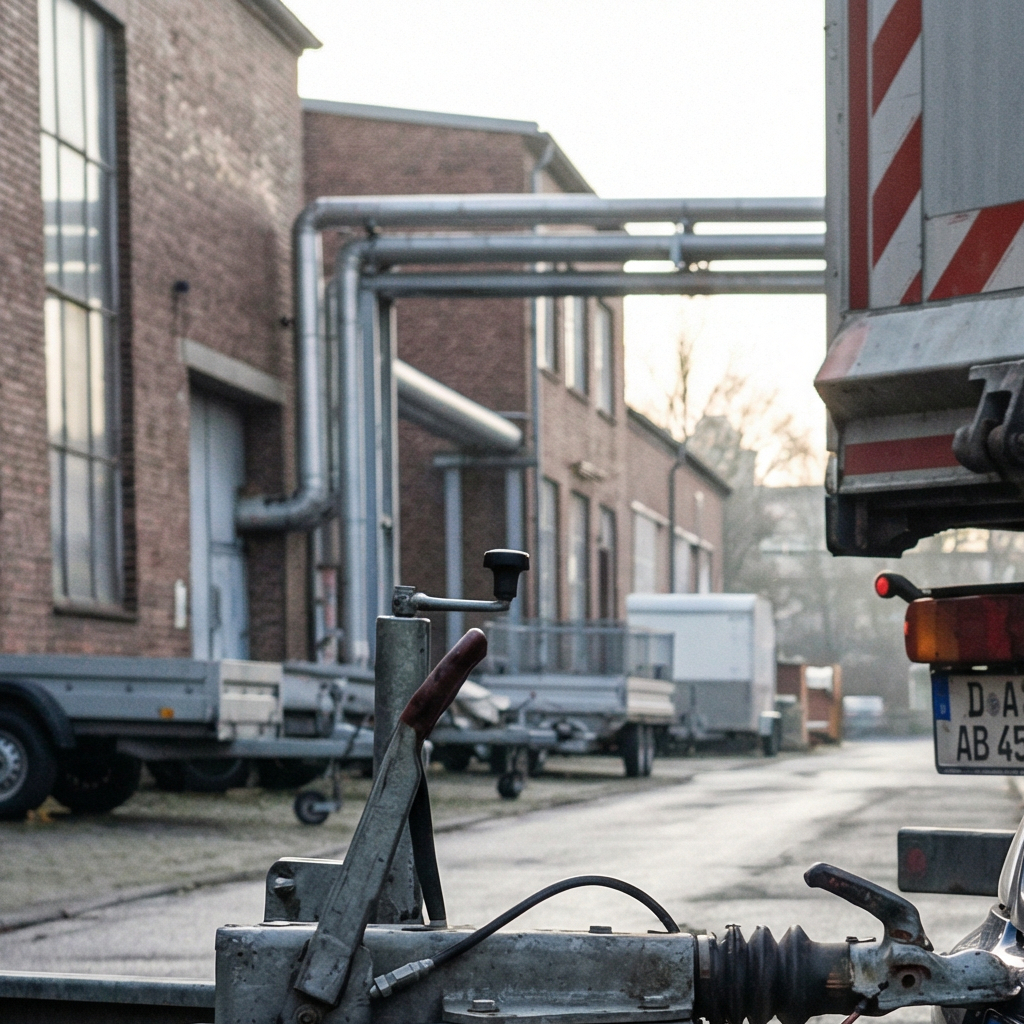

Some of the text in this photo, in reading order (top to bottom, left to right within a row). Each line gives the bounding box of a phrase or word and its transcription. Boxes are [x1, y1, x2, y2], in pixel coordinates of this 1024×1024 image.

[967, 681, 1019, 718] D A
[956, 725, 990, 762] AB
